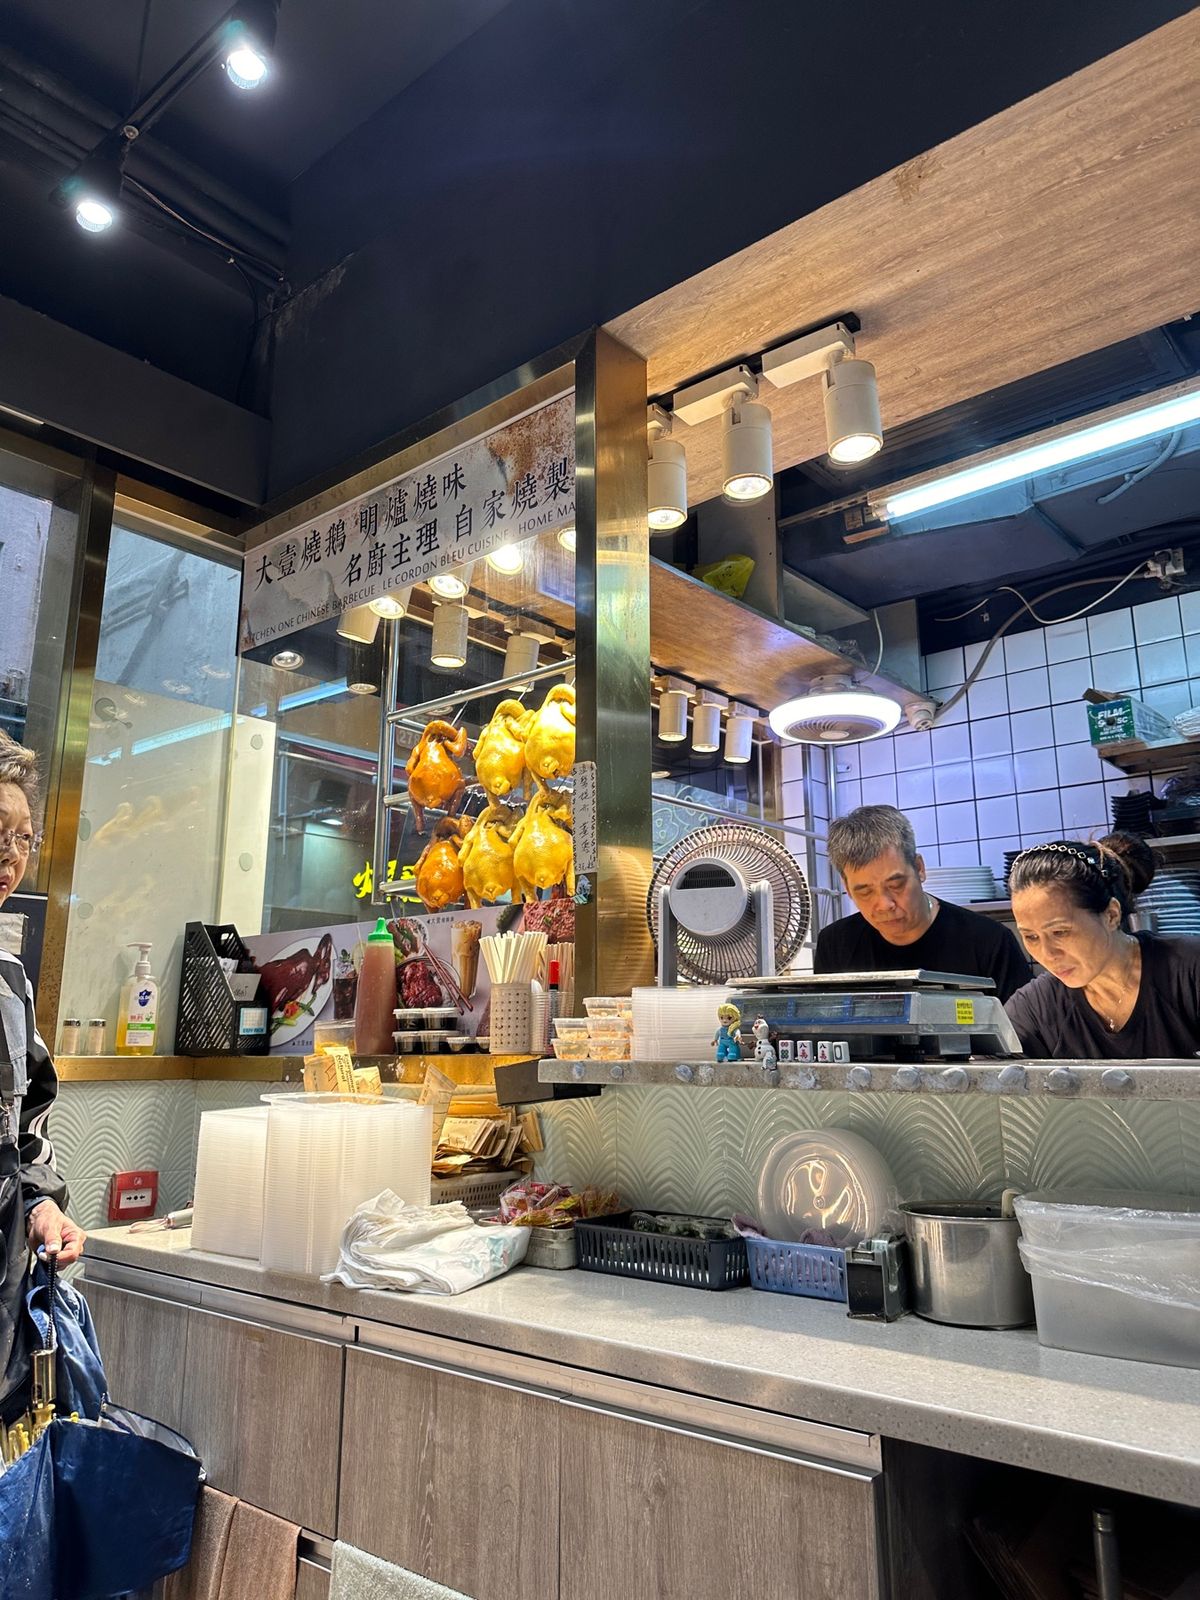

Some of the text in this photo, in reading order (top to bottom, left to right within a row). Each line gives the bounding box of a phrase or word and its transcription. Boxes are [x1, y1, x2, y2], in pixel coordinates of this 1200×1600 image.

[255, 463, 467, 592] 大壹燒鵝 明爐燒味
[278, 618, 295, 632] ONE
[296, 603, 330, 626] CHINESE
[332, 584, 376, 611] BARBECUE
[383, 576, 393, 590] LE
[395, 560, 438, 585] CORDON
[440, 547, 465, 566] BLEU
[467, 528, 509, 556] CUISINE
[518, 509, 553, 533] HOME
[342, 457, 571, 588] 名廚主理 自家燒製
[1097, 707, 1124, 720] FILM
